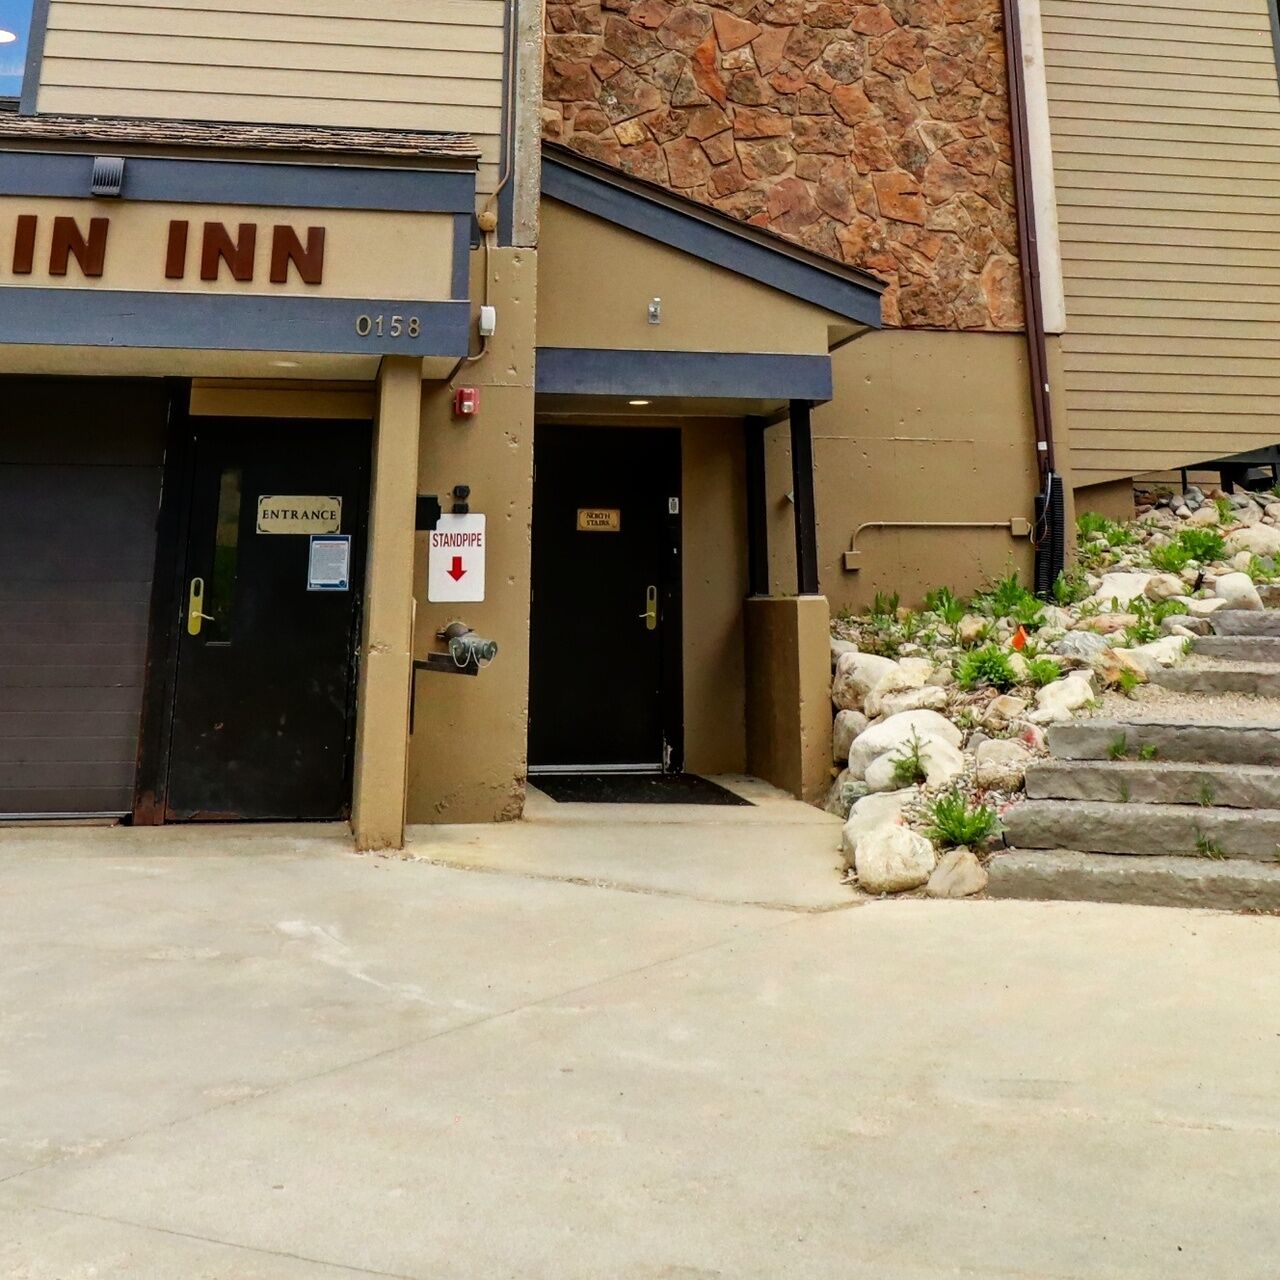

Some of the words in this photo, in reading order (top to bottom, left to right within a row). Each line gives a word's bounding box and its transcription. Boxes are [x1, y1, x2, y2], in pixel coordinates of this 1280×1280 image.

[164, 220, 326, 284] INN
[356, 314, 420, 337] 0158
[262, 509, 337, 520] ENTRANCE
[432, 532, 482, 548] STANDPIPE
